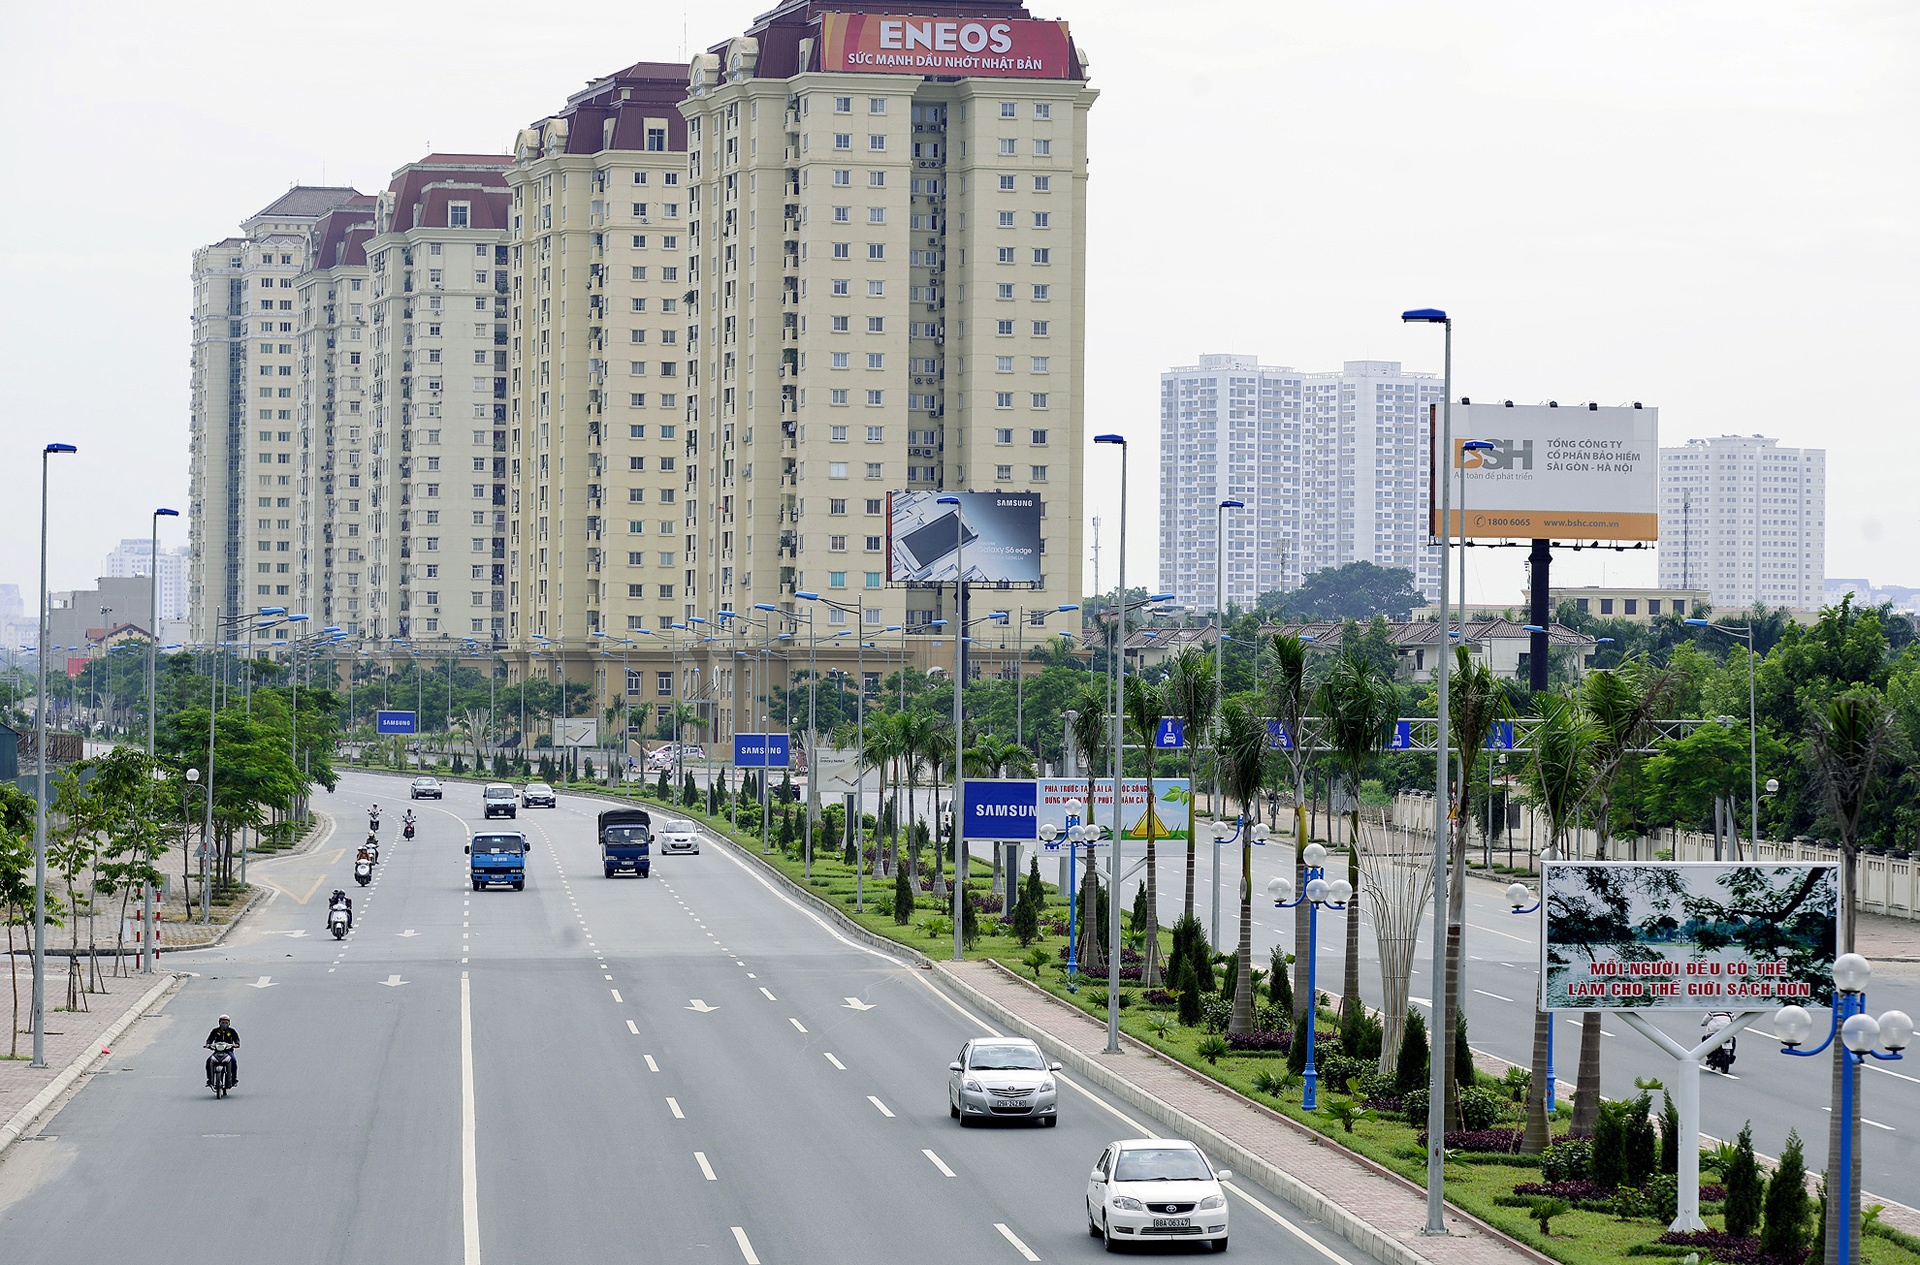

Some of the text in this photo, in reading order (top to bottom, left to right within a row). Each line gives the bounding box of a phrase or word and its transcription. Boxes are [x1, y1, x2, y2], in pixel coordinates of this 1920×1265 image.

[880, 20, 1012, 54] ENEOS
[848, 51, 1042, 72] SỨC MẠNH DẦU NHỚT NHẬT BẢN
[1547, 438, 1576, 448] TỔNG
[1578, 439, 1608, 448] CÔNG
[1592, 450, 1614, 460] BẢO
[1547, 461, 1563, 470] SÀI
[1566, 462, 1588, 471] GÒN
[1597, 462, 1612, 472] HÀ
[1614, 463, 1632, 474] NỘI
[1544, 519, 1619, 527] www.bshc.com.vn
[978, 546, 1004, 554] Galaxy
[1015, 548, 1032, 556] edge
[976, 804, 1037, 816] SAMSUN
[1590, 958, 1787, 975] MỖI NGƯỜI ĐỀU CÓ THỂ
[1568, 980, 1809, 998] LÀM CHO THẾ GIỚI SẠCH HƠN
